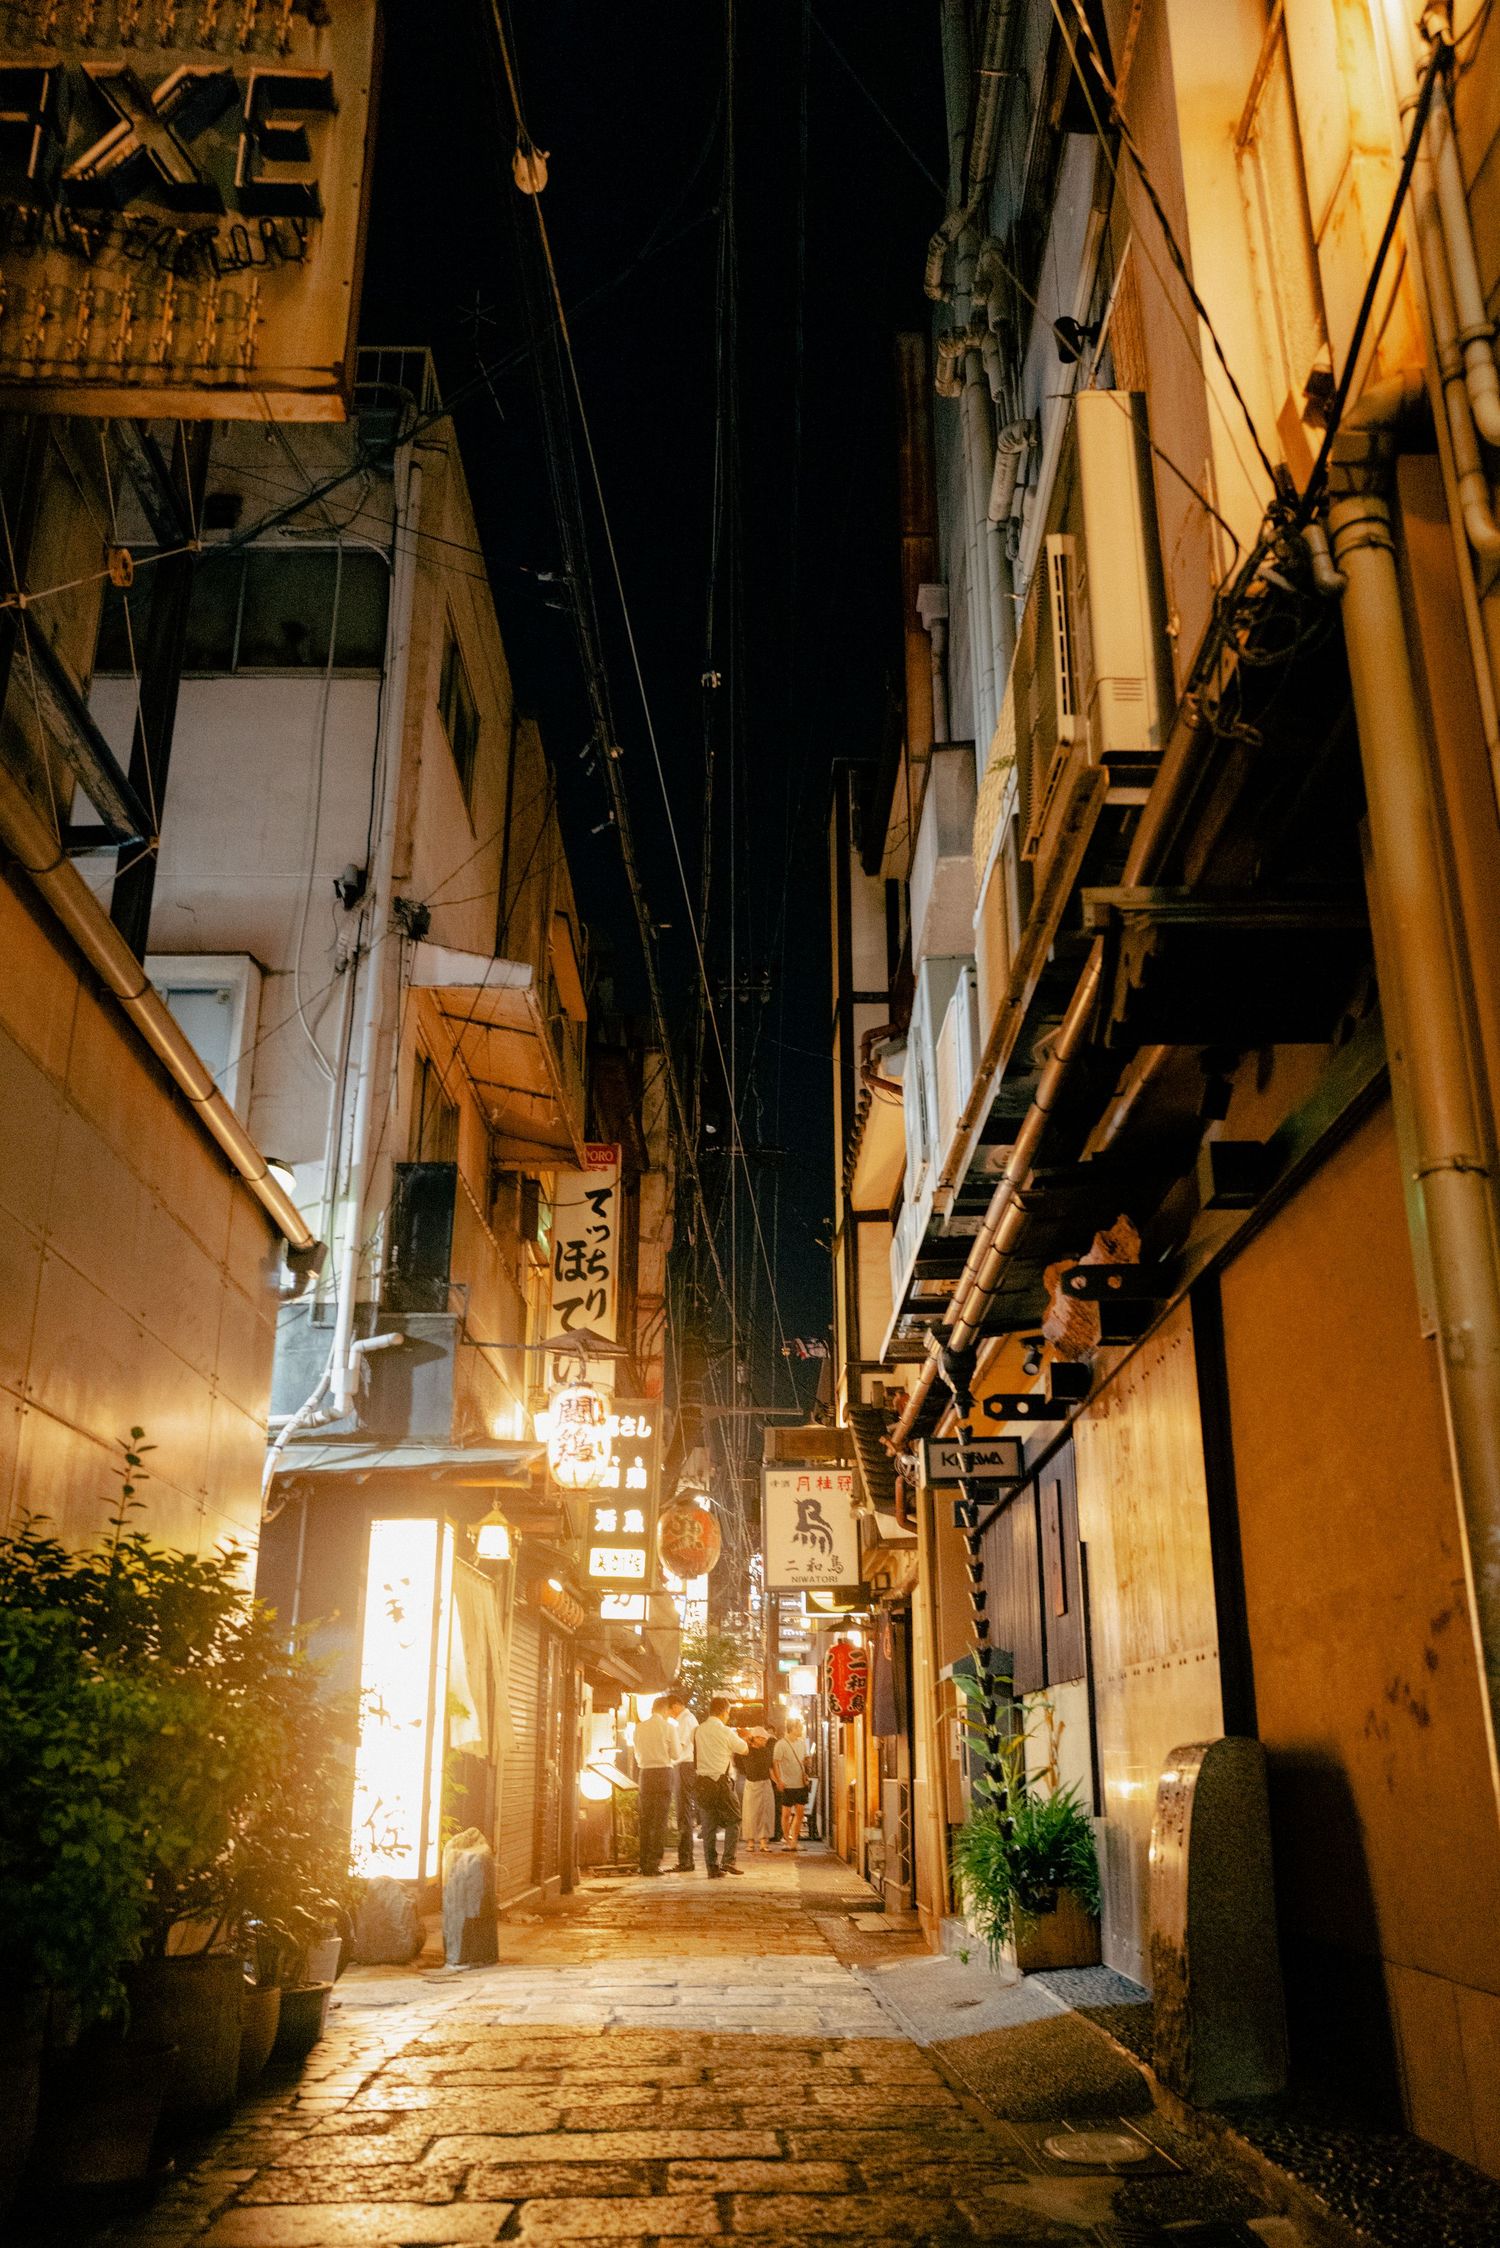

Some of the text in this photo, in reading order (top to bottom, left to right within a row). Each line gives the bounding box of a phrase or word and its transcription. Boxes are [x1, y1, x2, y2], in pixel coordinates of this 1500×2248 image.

[587, 1150, 614, 1162] ORO
[585, 1188, 613, 1321] てっちり
[796, 1475, 852, 1492] 月桂冠
[791, 1575, 839, 1583] NIWATORI
